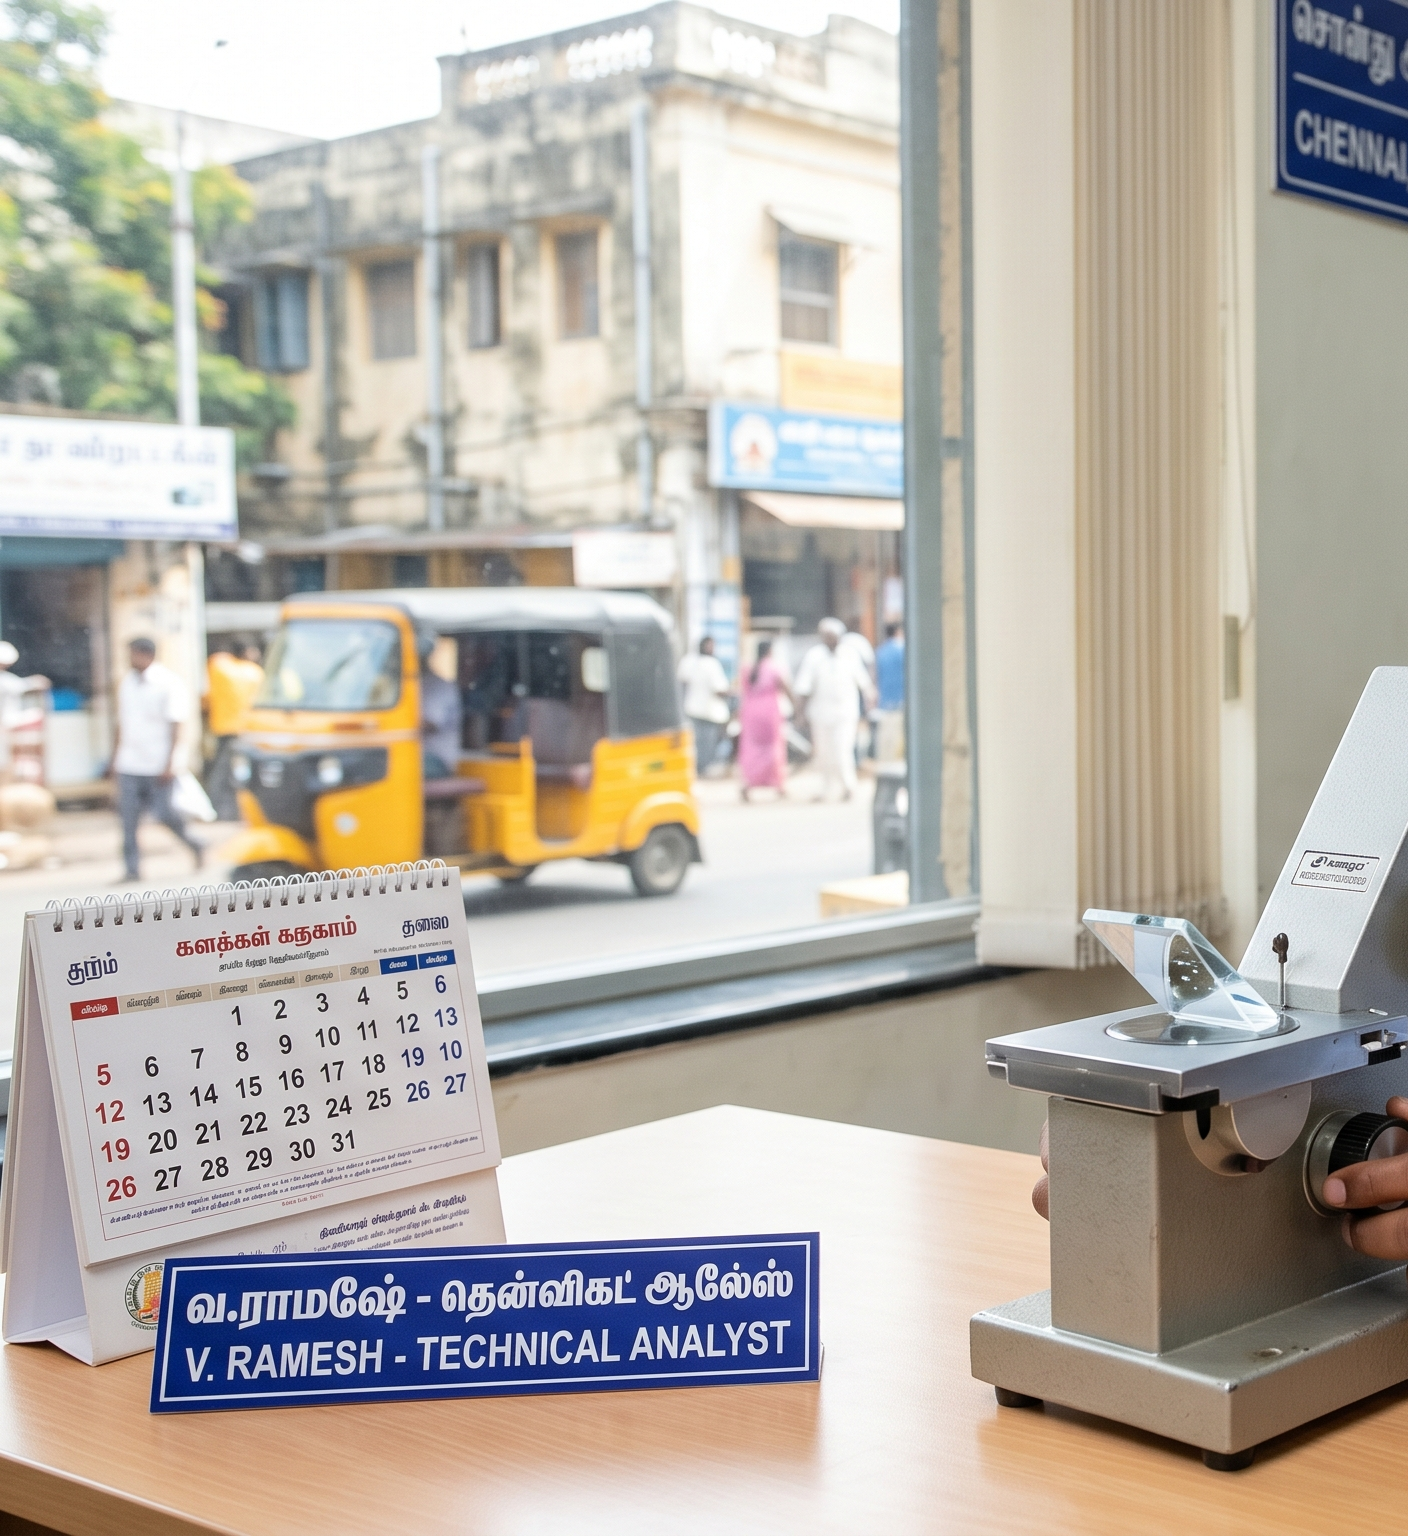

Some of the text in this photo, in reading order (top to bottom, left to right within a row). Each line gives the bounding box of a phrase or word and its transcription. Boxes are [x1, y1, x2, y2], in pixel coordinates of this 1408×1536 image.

[231, 973, 447, 1026] 1 2 3 4 5 6
[95, 1039, 463, 1125] 12 13 14 15 16 17 18 19 10
[97, 1006, 458, 1086] 5 6 7 8 9 10 11 12 13
[100, 1072, 467, 1163] 19 20 21 22 23 24 25 26 27
[106, 1129, 355, 1203] 26 27 28 29 30 31
[185, 1346, 214, 1381] V.
[226, 1338, 384, 1380] RAMESH
[416, 1328, 620, 1371] TECHNICAL
[629, 1320, 791, 1361] ANALYST
